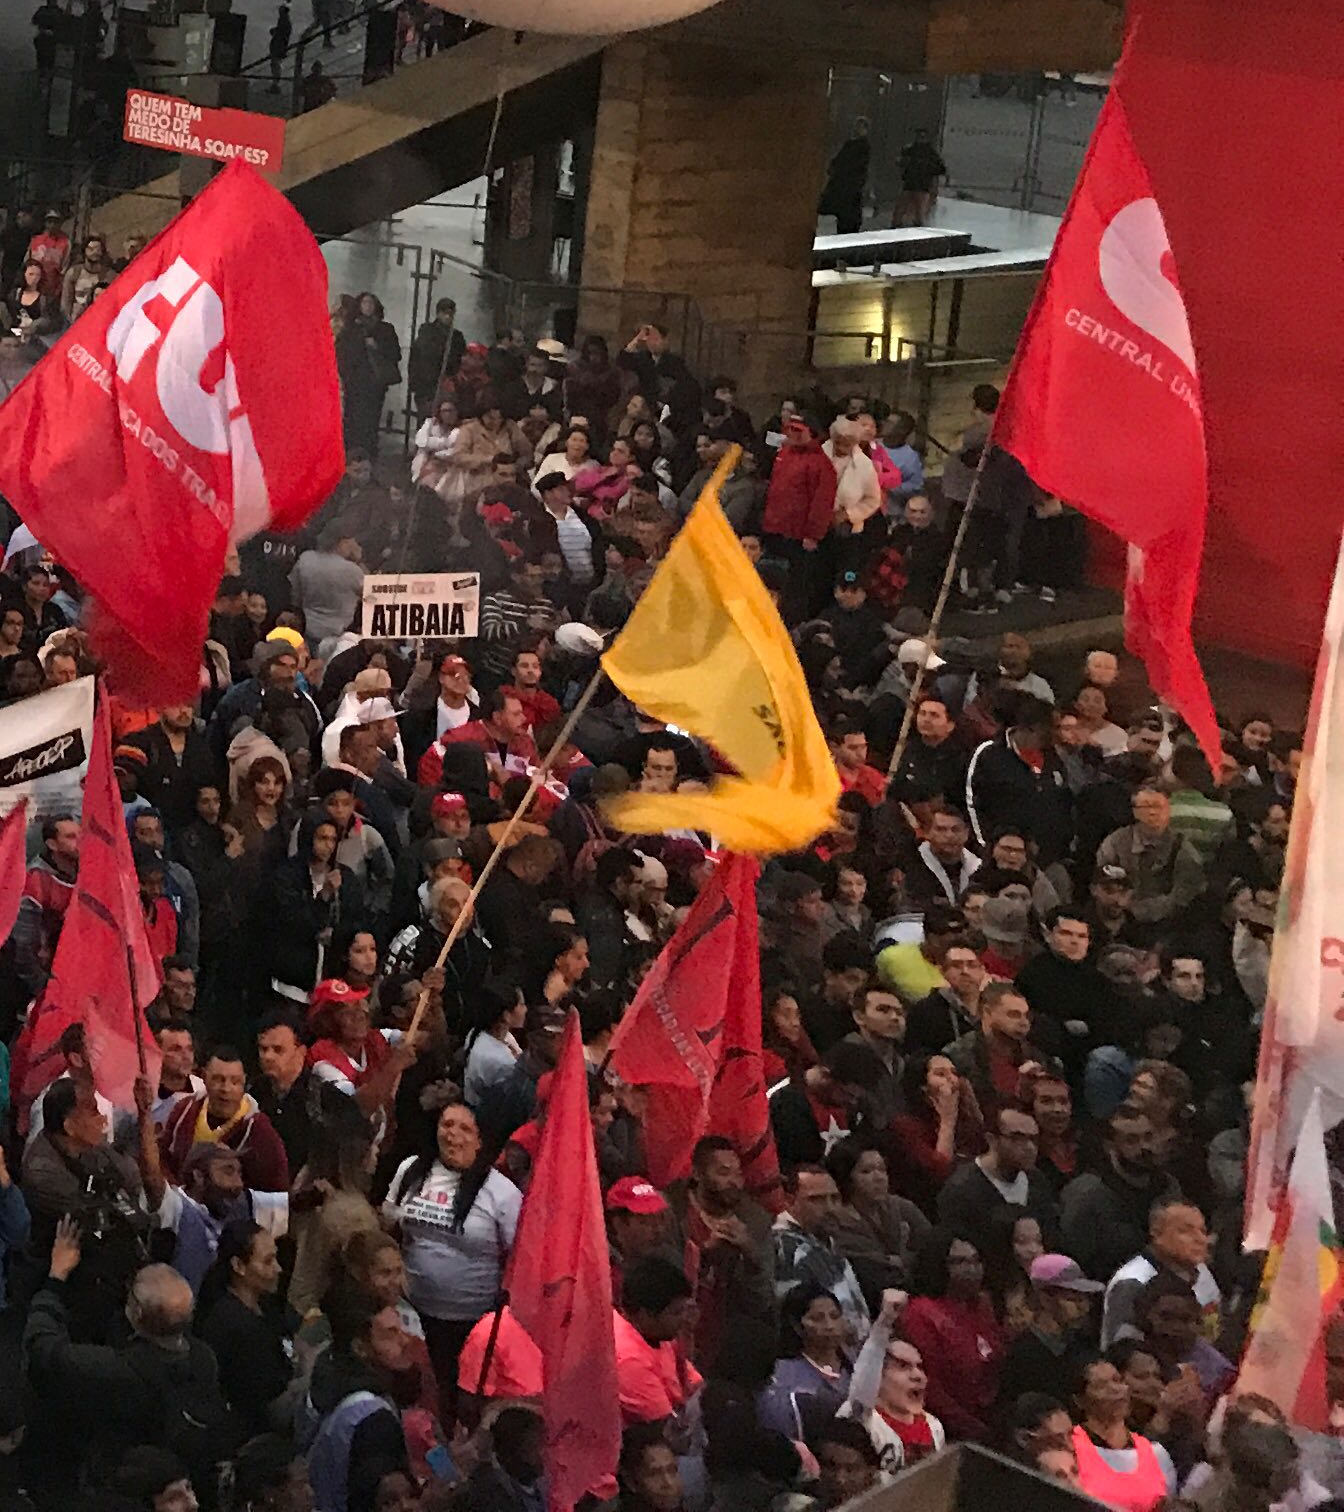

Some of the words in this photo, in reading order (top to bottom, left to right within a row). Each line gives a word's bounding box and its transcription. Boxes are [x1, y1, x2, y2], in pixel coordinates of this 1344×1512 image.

[129, 109, 170, 129] MEDO
[173, 119, 190, 133] DE
[130, 93, 171, 115] QUEM
[175, 103, 202, 121] TEM
[128, 123, 201, 152] TERESINHA
[1065, 308, 1163, 382] CENTRAL
[67, 343, 112, 395] CENTRAL
[140, 428, 179, 472] DOS
[371, 603, 465, 636] ATIBAIA
